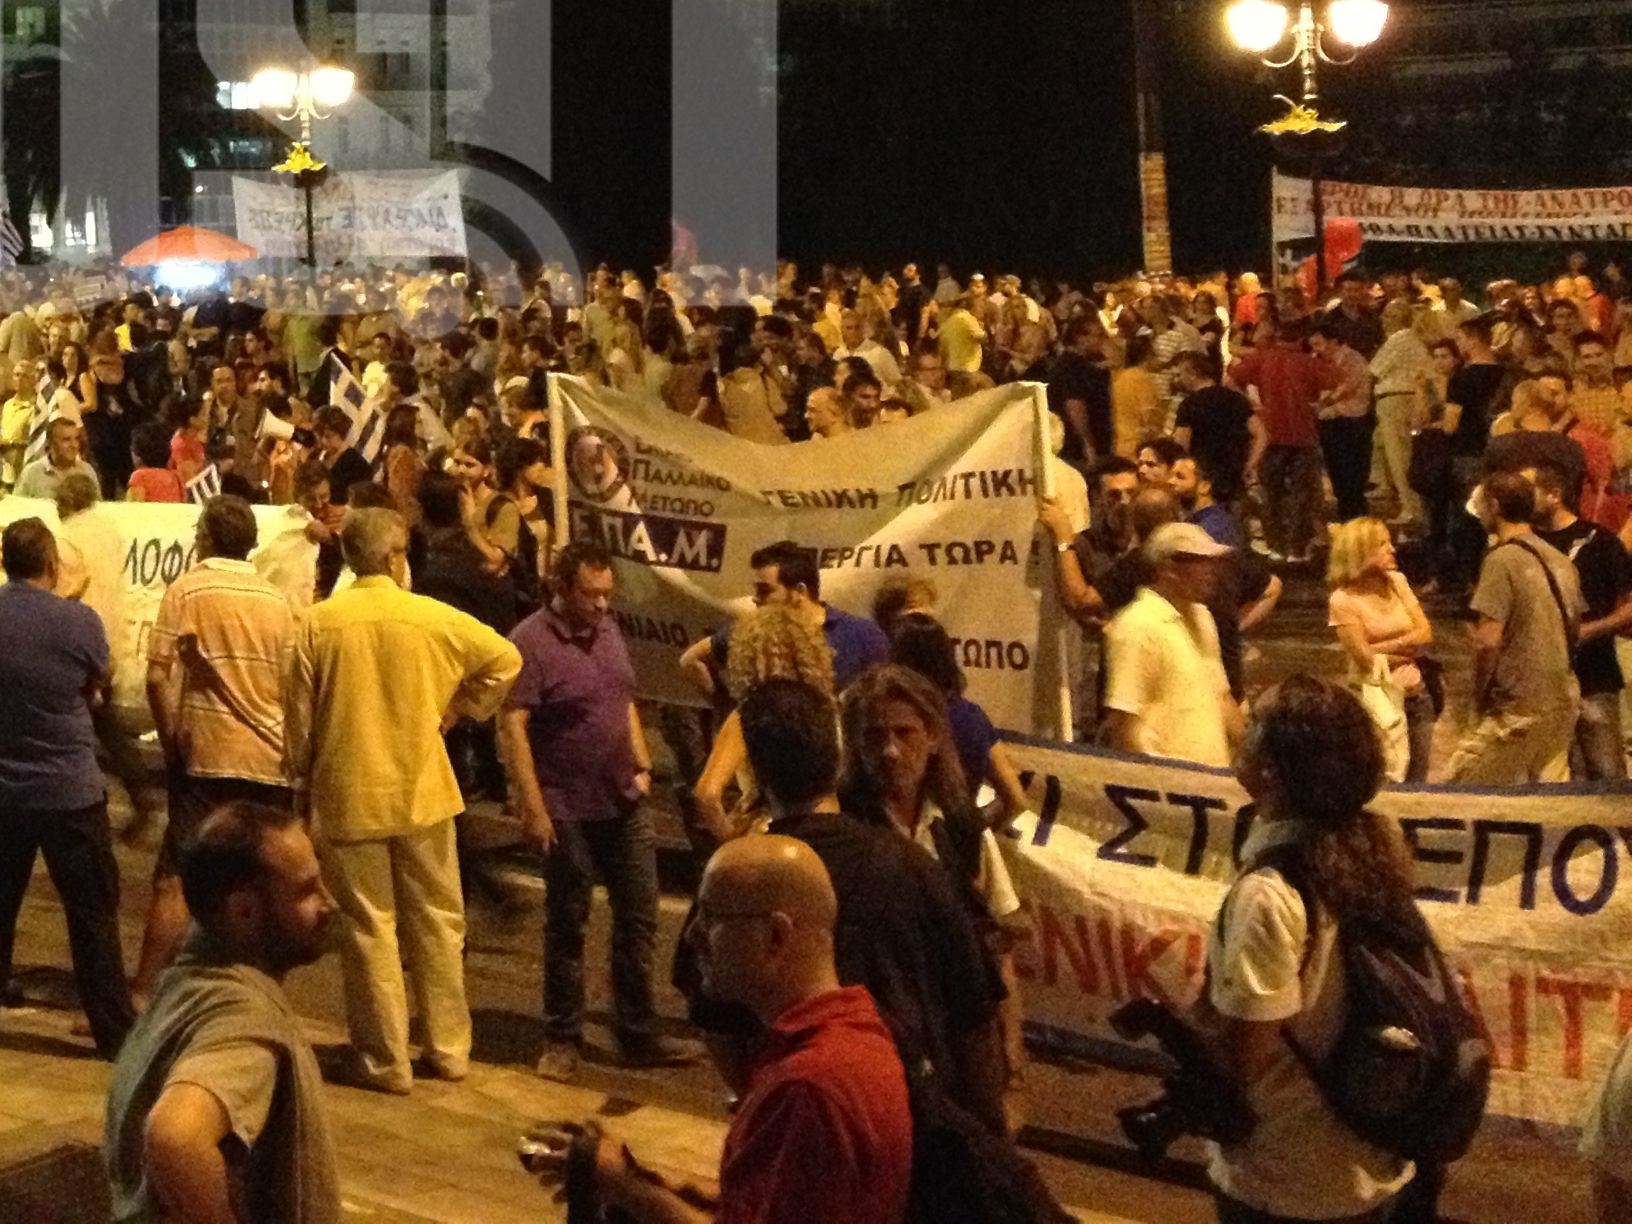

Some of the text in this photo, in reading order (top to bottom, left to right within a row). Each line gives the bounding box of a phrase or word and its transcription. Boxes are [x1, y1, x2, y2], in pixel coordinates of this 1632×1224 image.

[760, 468, 1036, 510] ΓΕΝΙΚΗ ΠΟΛΙΤΙΚΗ
[817, 543, 909, 569] ΕΡΓΙΑ
[919, 540, 1018, 567] ΤΩΡΑ
